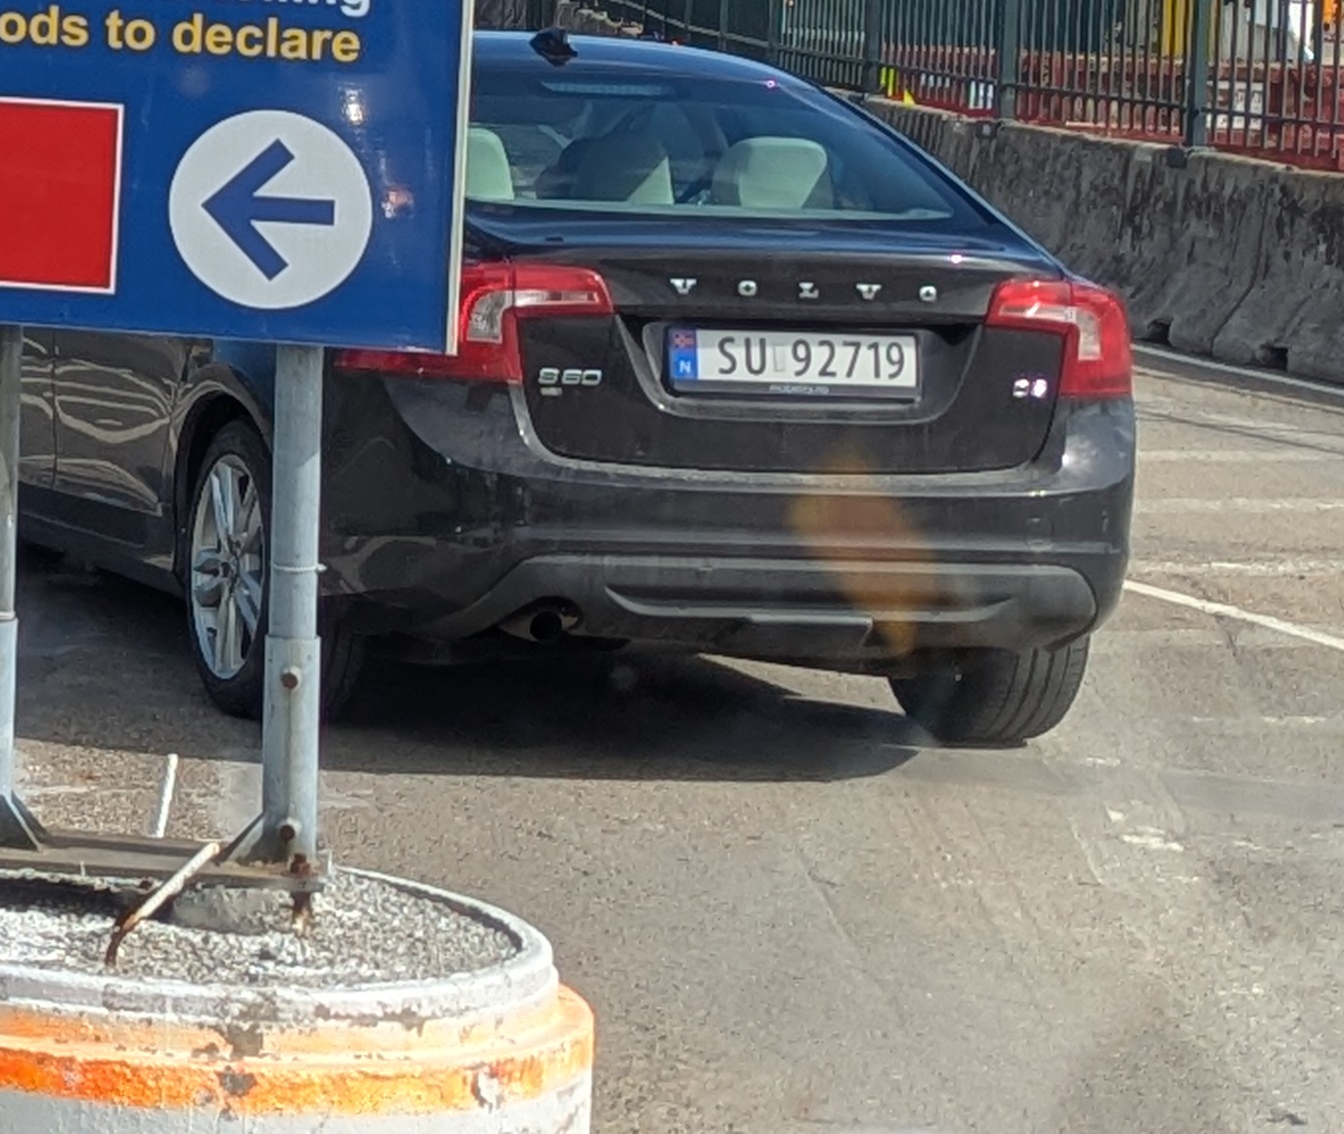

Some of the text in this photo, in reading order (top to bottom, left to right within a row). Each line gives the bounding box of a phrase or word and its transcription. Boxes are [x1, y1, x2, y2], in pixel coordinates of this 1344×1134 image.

[105, 9, 155, 51] to
[172, 13, 362, 62] declare
[670, 278, 937, 302] VOLVO
[718, 337, 905, 379] SU 92719
[538, 368, 602, 385] S60
